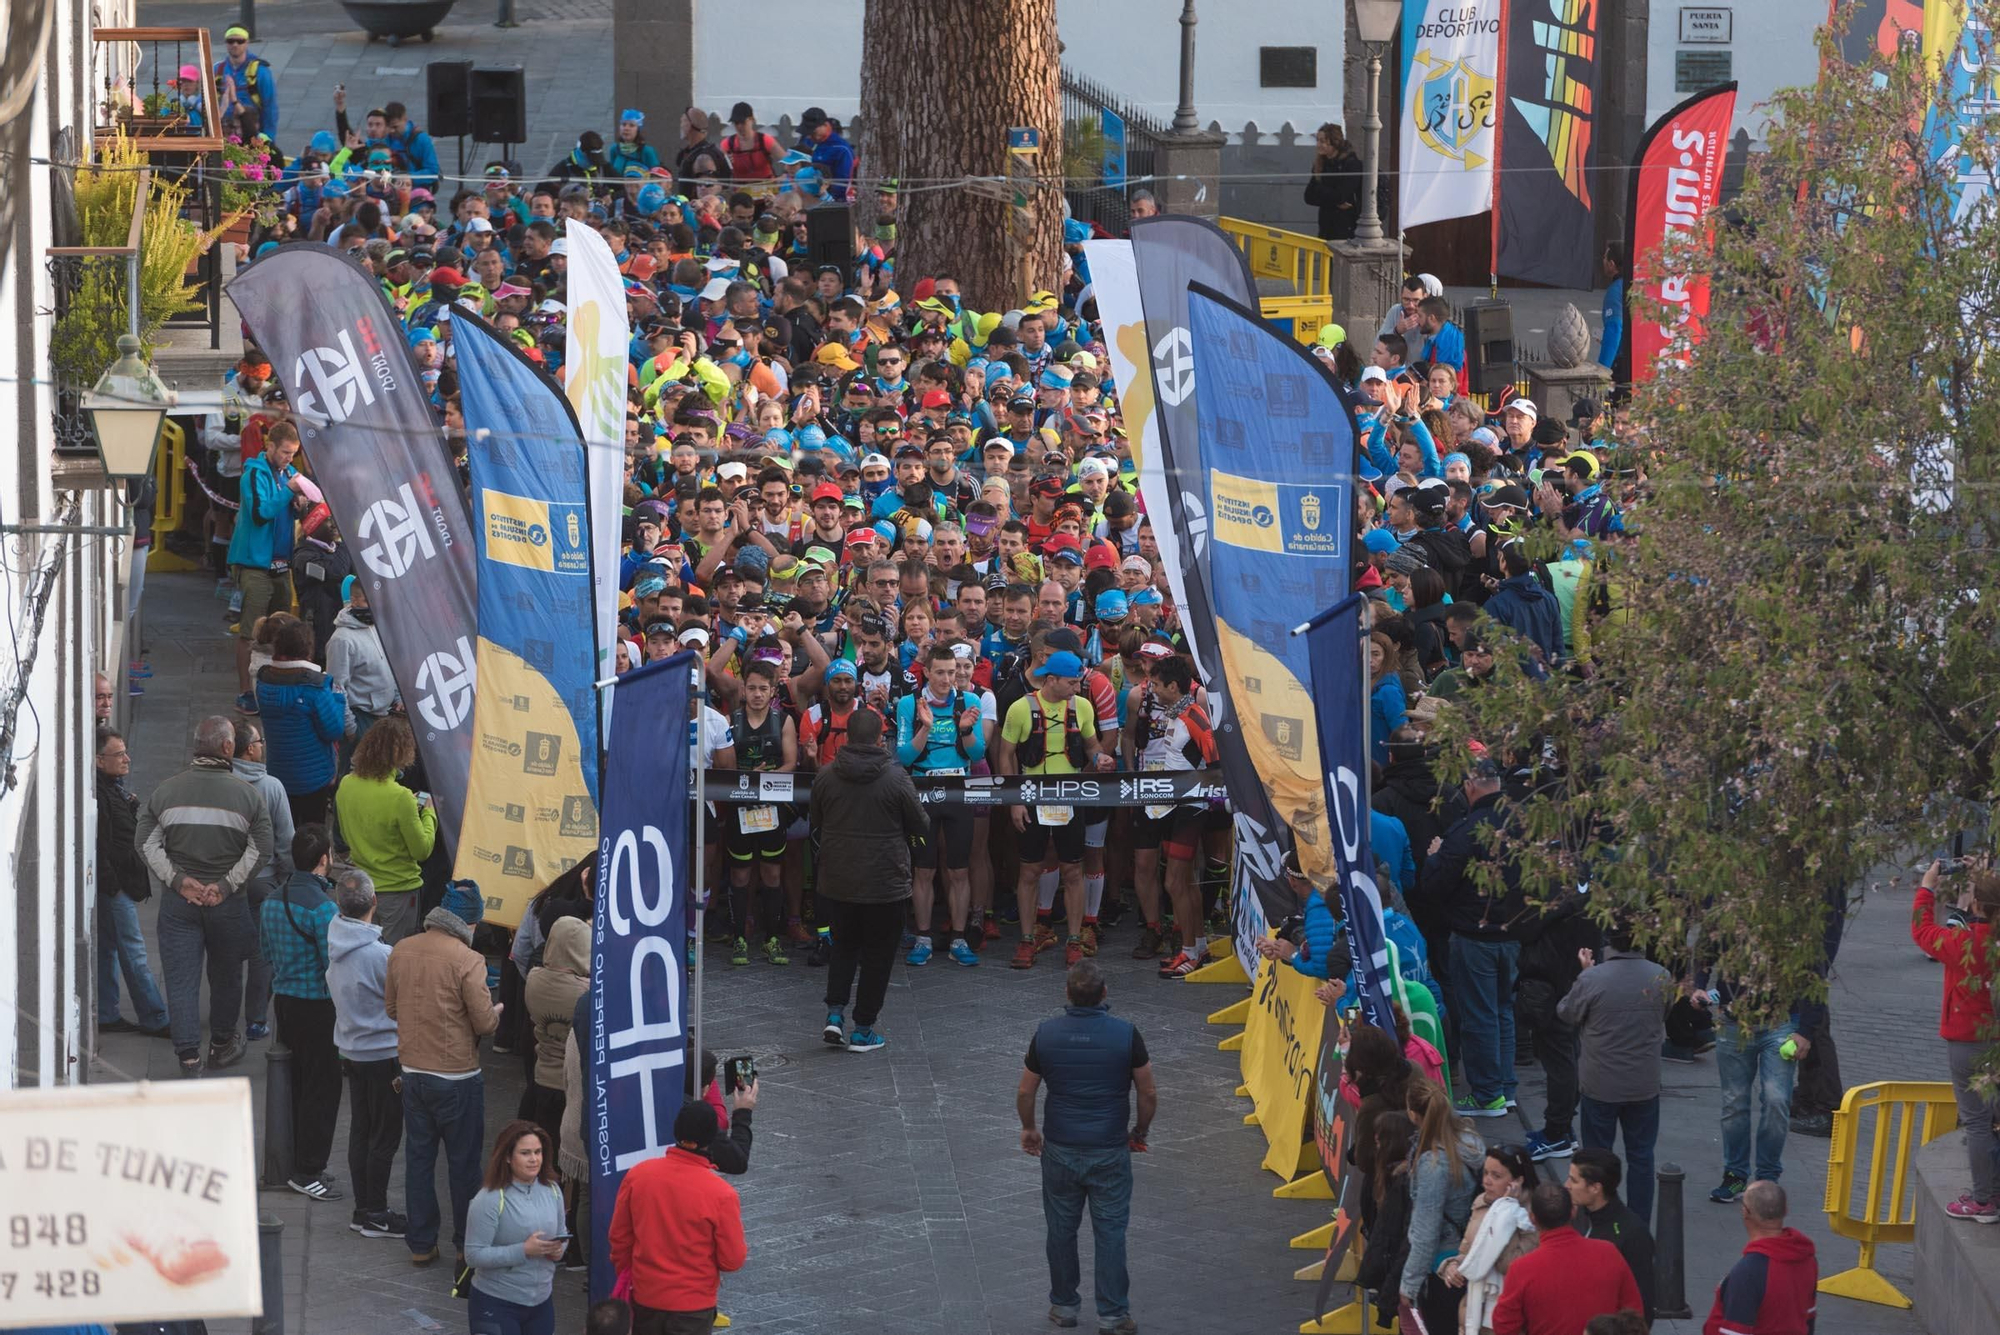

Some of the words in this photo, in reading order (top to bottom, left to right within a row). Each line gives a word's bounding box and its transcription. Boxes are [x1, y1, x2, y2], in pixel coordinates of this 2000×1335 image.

[1438, 6, 1476, 23] CLUB
[1415, 19, 1500, 39] DEPORTIVO
[1040, 780, 1100, 798] HPS
[1140, 779, 1174, 793] RS
[25, 1136, 78, 1172] DE
[98, 1142, 228, 1204] TUNTE
[10, 1213, 87, 1249] 948
[34, 1270, 101, 1298] 428
